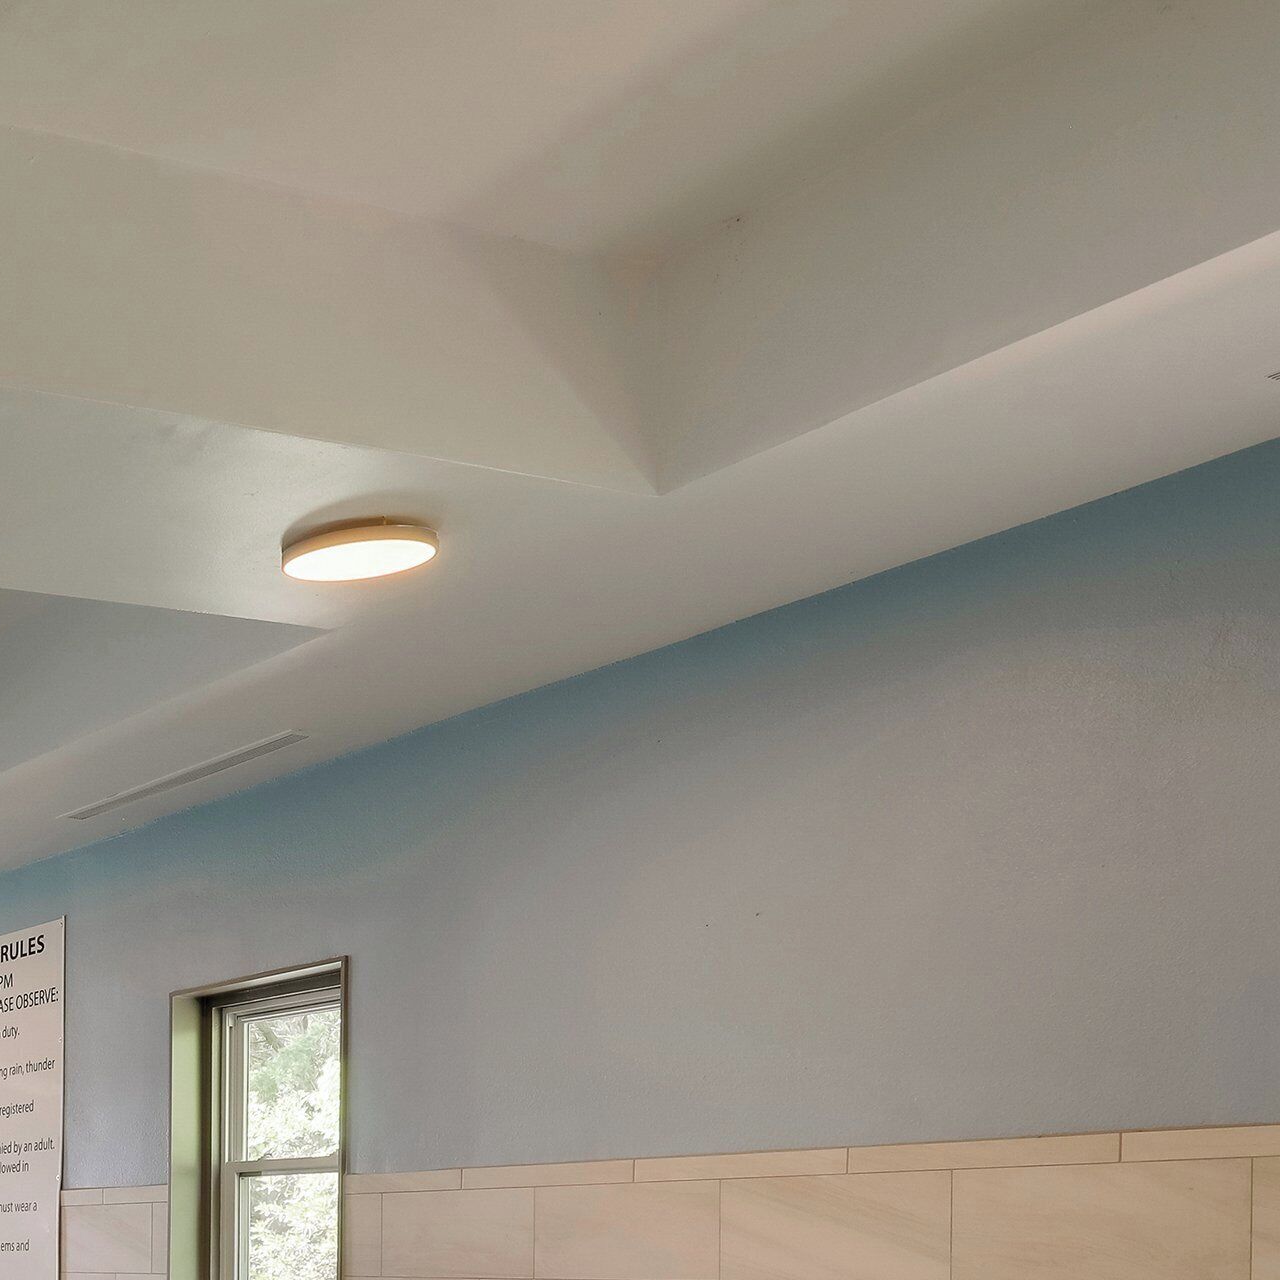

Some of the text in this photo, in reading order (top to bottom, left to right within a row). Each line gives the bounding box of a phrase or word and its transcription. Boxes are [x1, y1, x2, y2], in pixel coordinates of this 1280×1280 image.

[0, 934, 45, 963] RULES
[15, 986, 59, 1010] OBSERVE:
[2, 1026, 20, 1039] duty.
[9, 1063, 24, 1076] rain,
[25, 1057, 55, 1073] thunder
[0, 1099, 34, 1118] registered
[13, 1141, 22, 1155] by
[24, 1142, 32, 1152] an
[34, 1137, 55, 1151] adult.
[22, 1160, 29, 1172] in
[14, 1202, 31, 1212] wear
[32, 1202, 38, 1212] a
[16, 1239, 30, 1251] and
